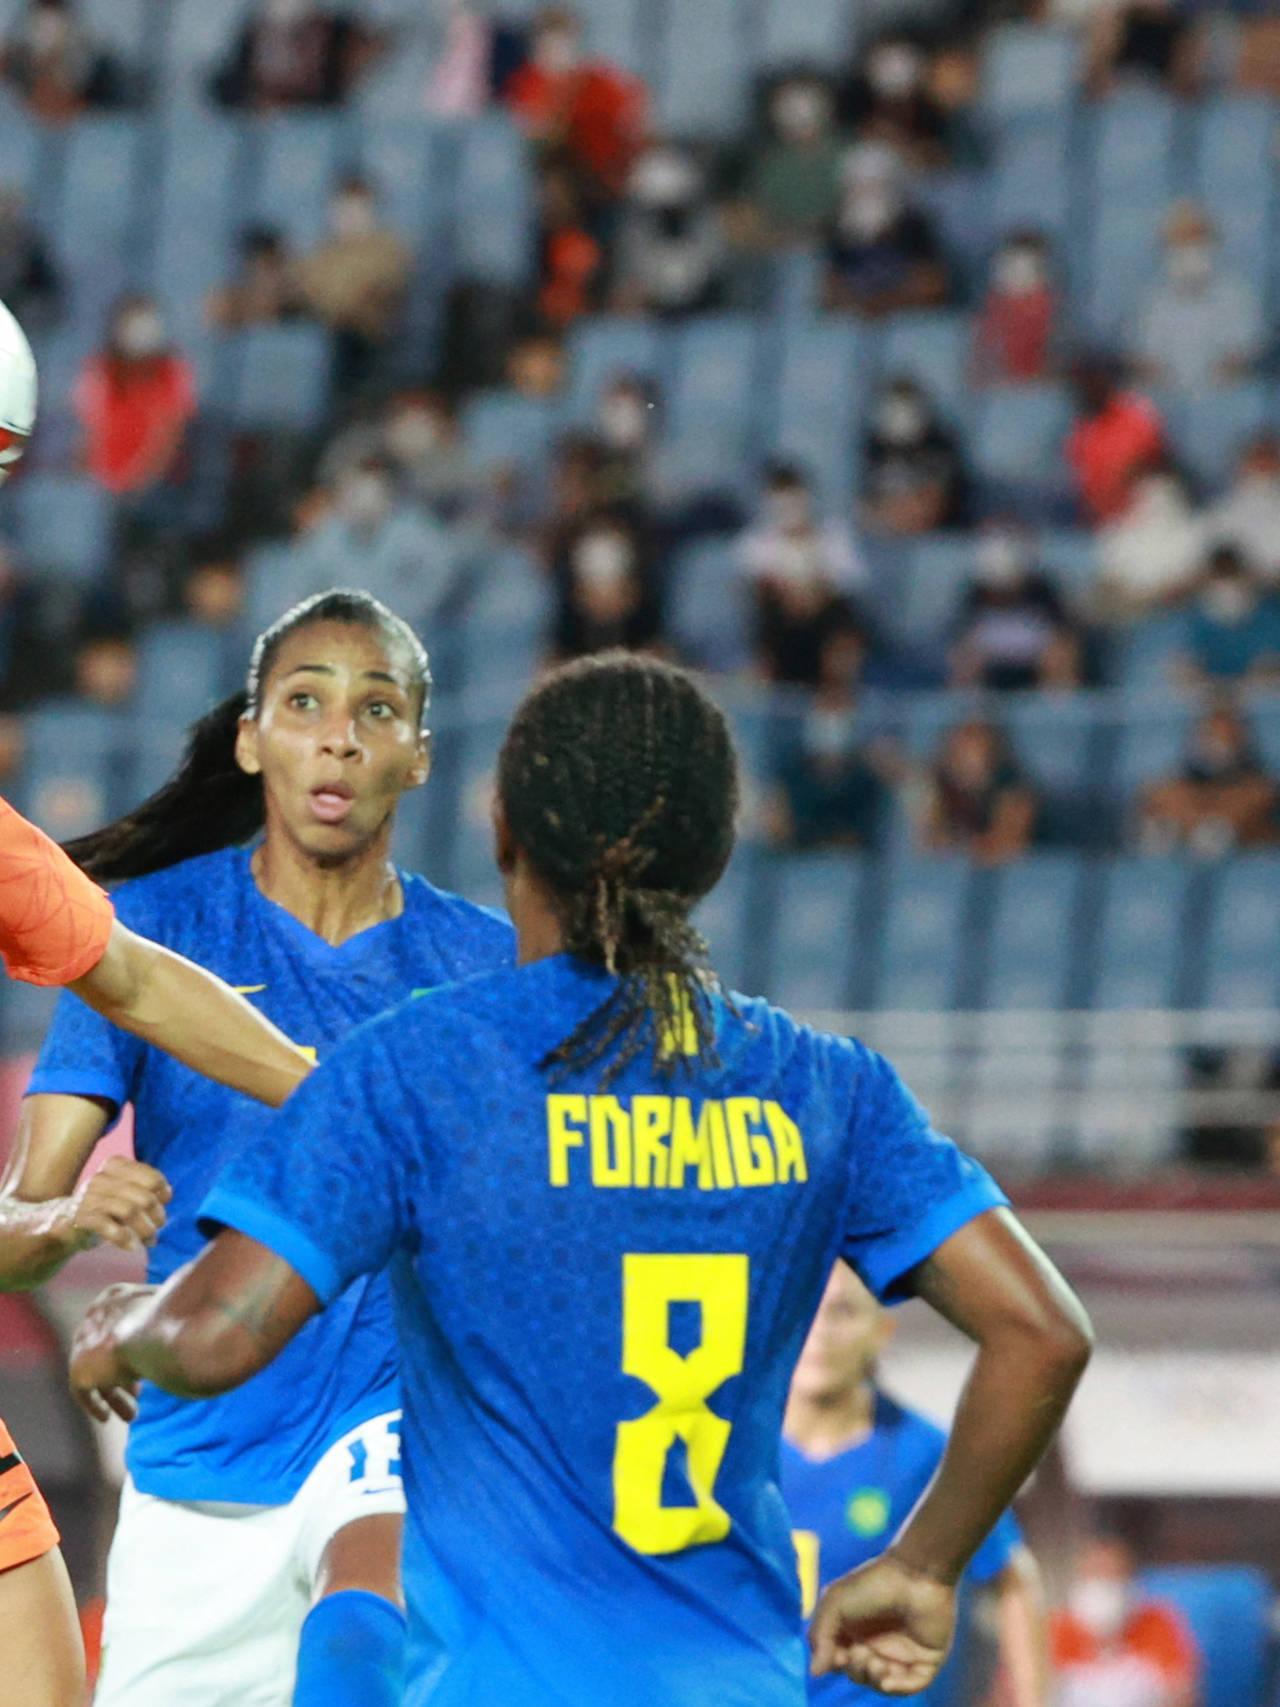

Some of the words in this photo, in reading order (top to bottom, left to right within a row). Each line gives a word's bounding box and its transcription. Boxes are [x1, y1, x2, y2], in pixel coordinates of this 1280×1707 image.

[546, 1093, 809, 1190] FORMIGA
[347, 1420, 402, 1483] 1
[612, 1253, 749, 1555] 8
